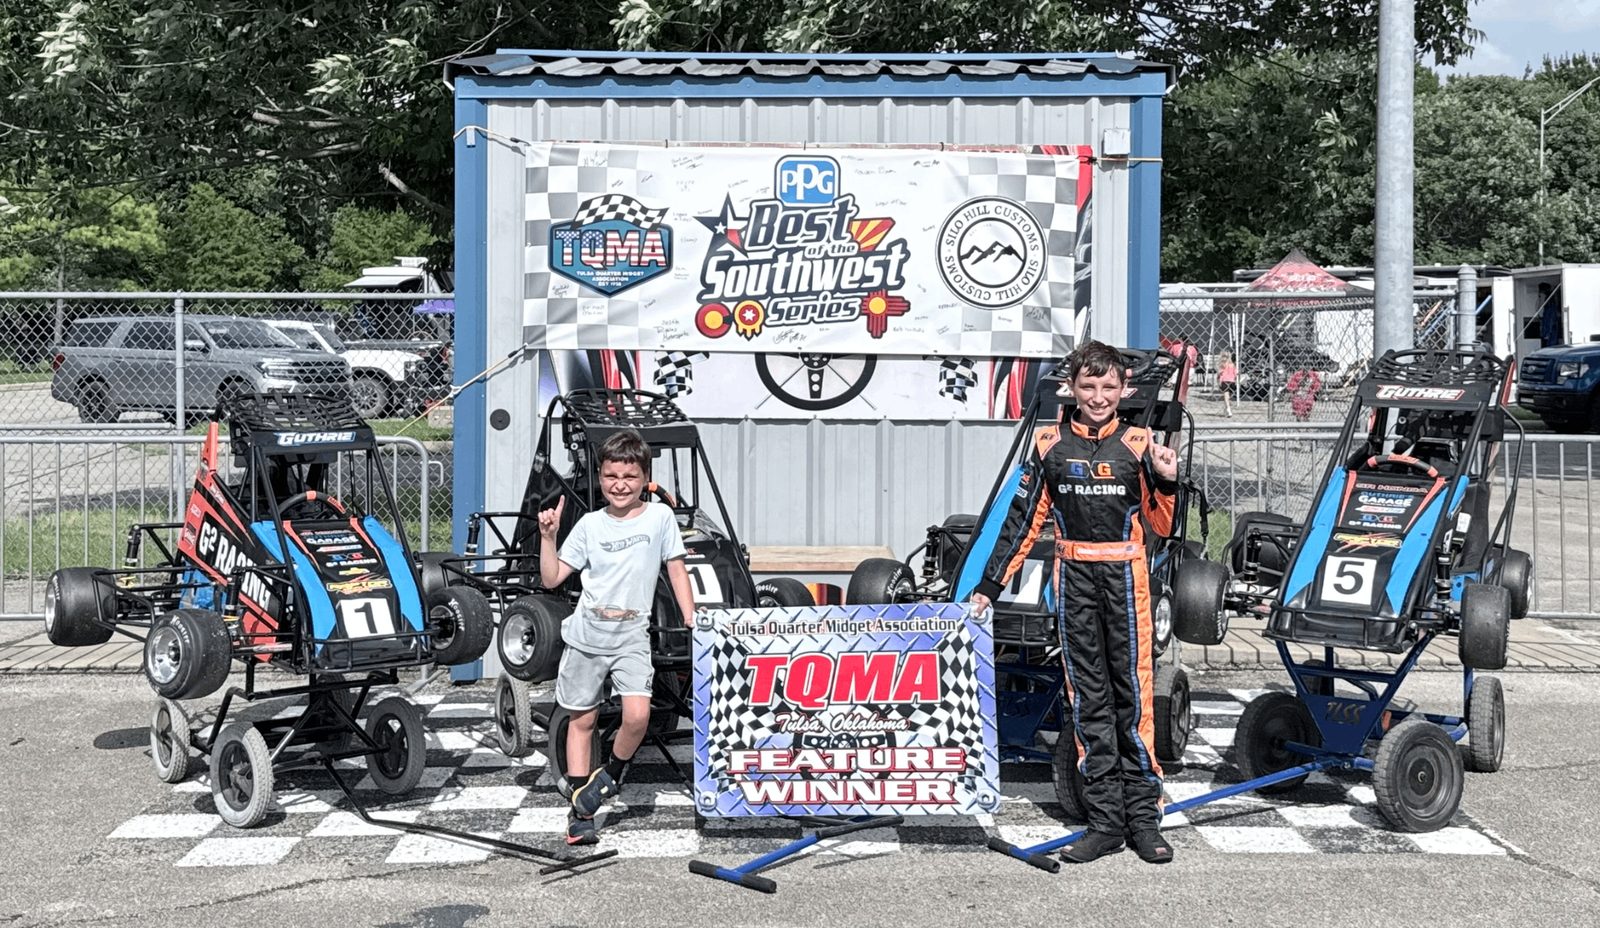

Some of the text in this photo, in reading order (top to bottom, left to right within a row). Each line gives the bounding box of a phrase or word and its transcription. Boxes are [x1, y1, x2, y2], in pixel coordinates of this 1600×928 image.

[781, 163, 834, 200] PPG
[748, 194, 856, 248] Best
[945, 204, 1040, 252] SILO HILL CUSTOMS
[555, 229, 667, 270] TQMA
[807, 243, 856, 258] of the
[701, 242, 909, 300] Southwest
[944, 254, 1039, 301] SILO HILL CUSTOMS
[766, 293, 861, 321] Series
[1378, 384, 1464, 401] GUTHRIE
[277, 431, 355, 446] GUTHRIE
[1075, 484, 1126, 496] RACING
[1358, 495, 1414, 508] GARAGE
[306, 535, 360, 545] GARAGE
[687, 566, 707, 595] 1
[1333, 560, 1364, 595] 5
[354, 601, 378, 634] 1
[730, 617, 957, 636] Tulsa Quarter Midget Association
[745, 651, 942, 709] TQMA
[776, 714, 909, 732] Tulsa, Oklahoma
[729, 748, 966, 773] FEATURE
[740, 780, 957, 804] WINNER
